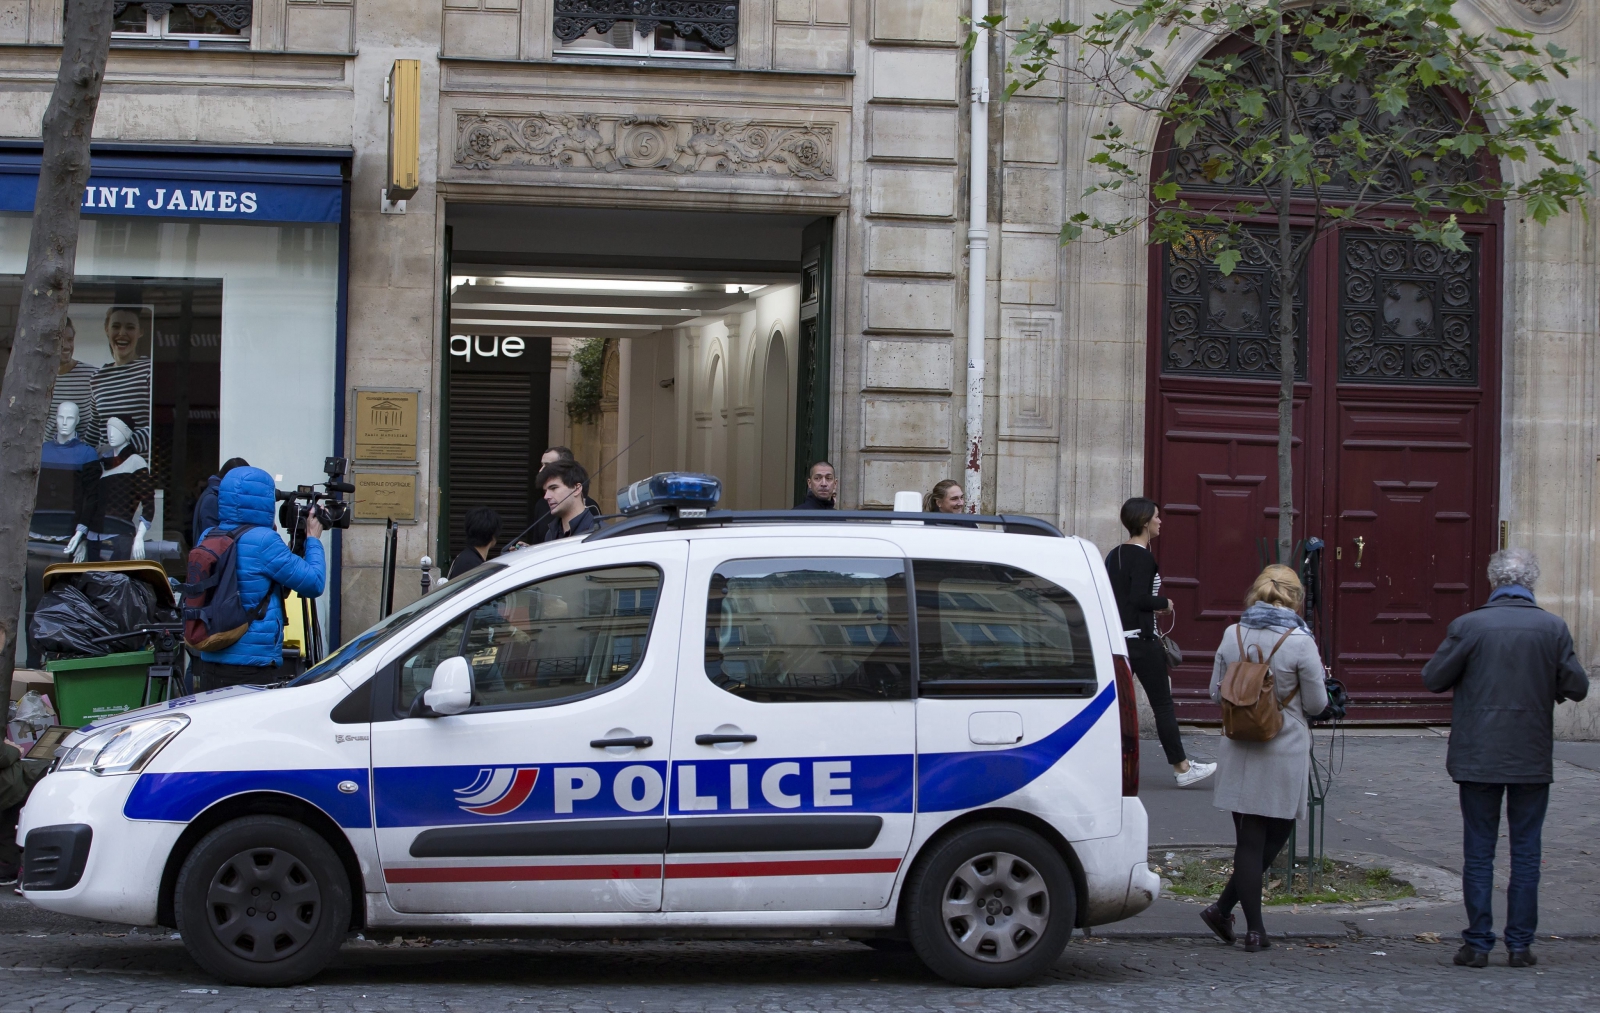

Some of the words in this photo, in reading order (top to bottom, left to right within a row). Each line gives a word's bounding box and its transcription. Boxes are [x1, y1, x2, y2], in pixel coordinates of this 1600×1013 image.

[639, 136, 653, 157] 5
[80, 186, 140, 209] INT
[147, 188, 258, 213] JAMES
[553, 760, 853, 814] POLICE
